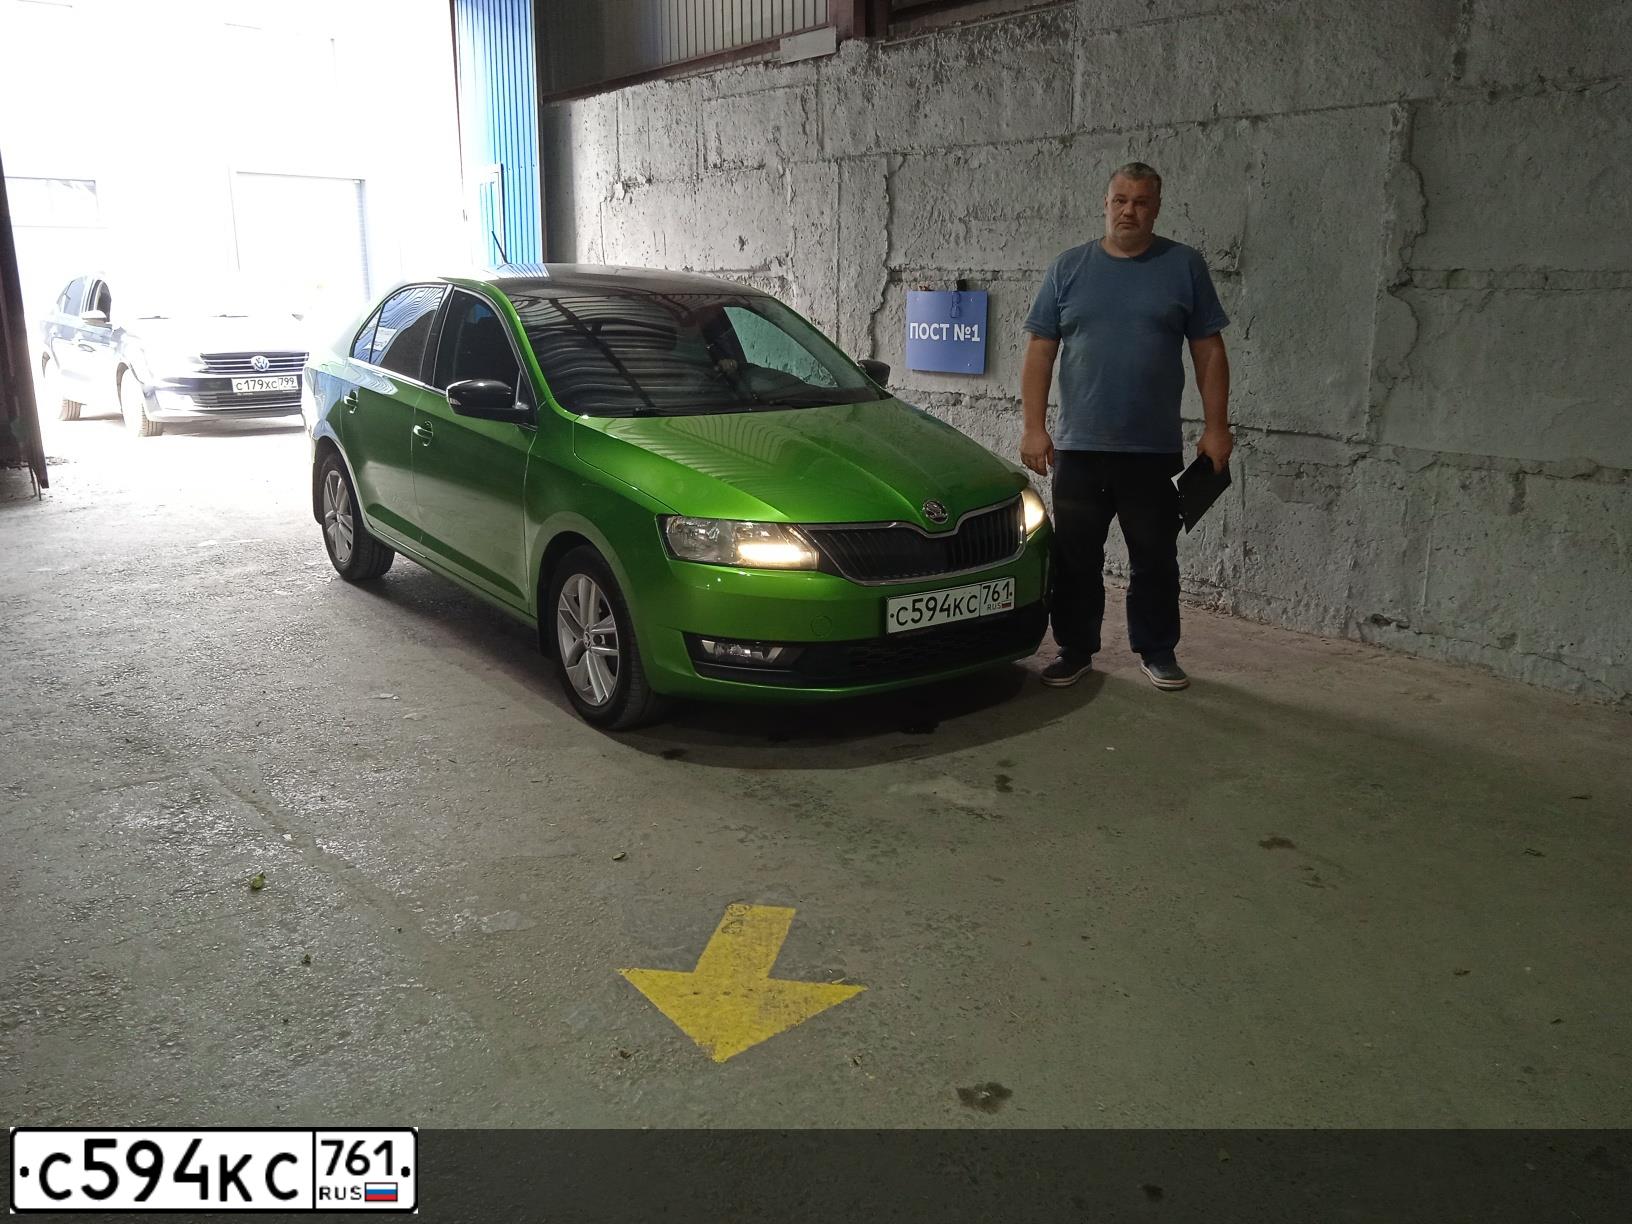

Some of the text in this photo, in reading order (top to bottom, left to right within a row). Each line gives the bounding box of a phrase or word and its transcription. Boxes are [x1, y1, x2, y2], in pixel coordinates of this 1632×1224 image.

[909, 322, 981, 342] ПОСТ №1
[279, 377, 295, 386] 799
[896, 581, 1010, 626] С594КС 761
[986, 603, 1002, 611] RUS
